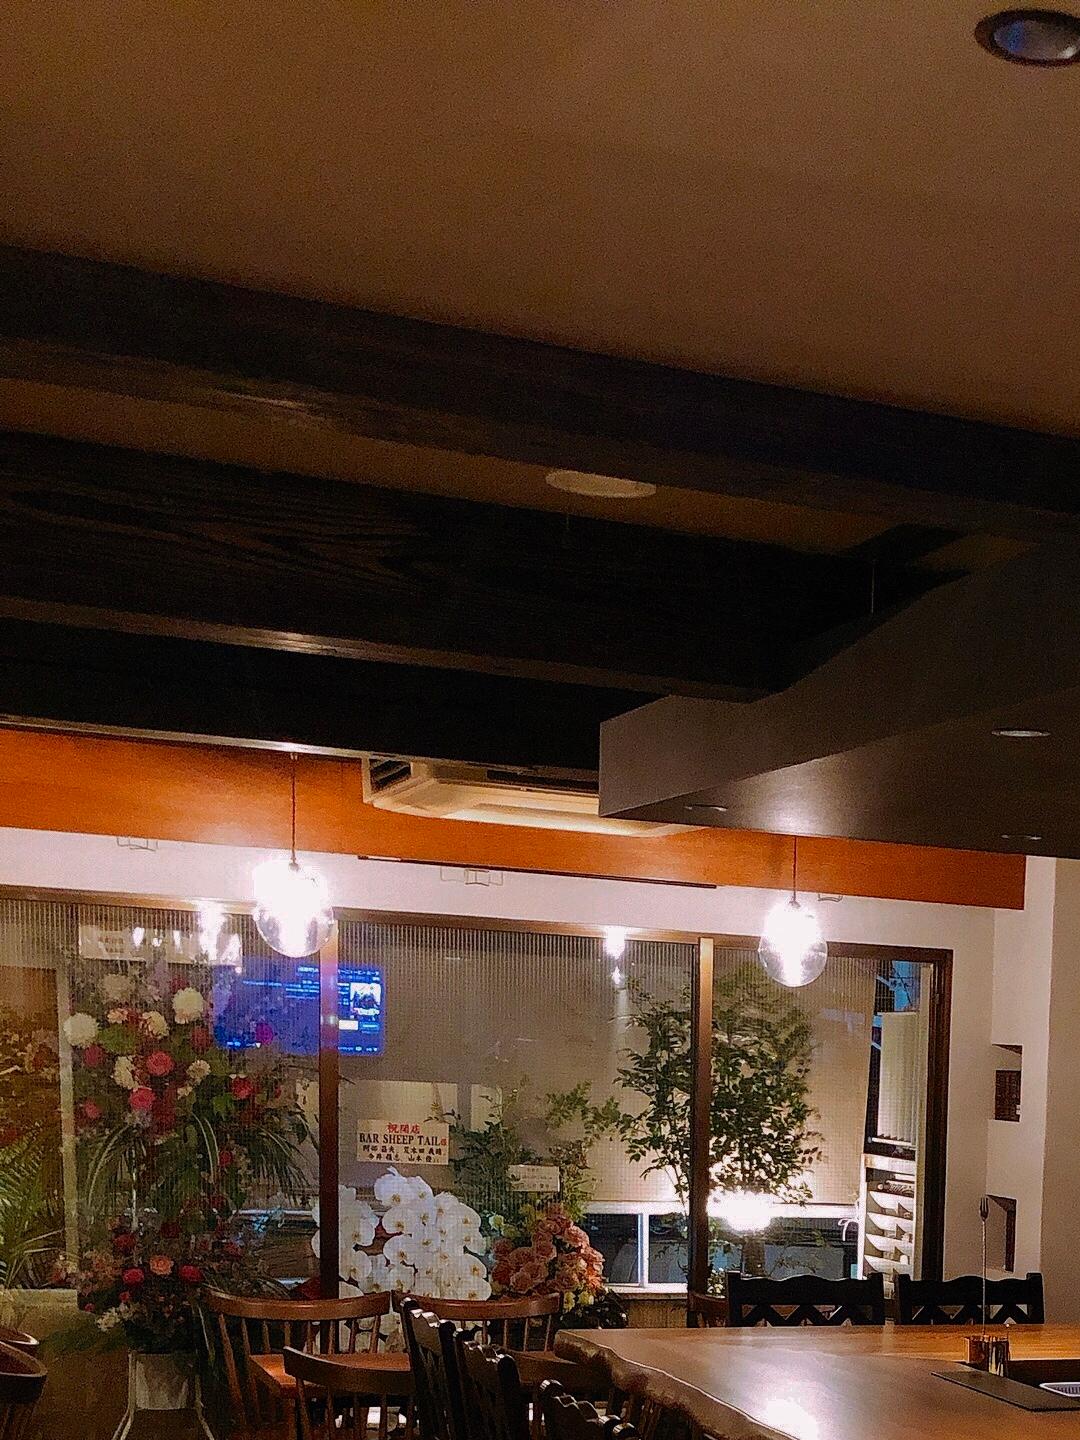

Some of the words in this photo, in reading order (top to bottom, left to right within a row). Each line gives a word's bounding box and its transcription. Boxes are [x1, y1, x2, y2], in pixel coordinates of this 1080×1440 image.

[360, 1133, 379, 1143] BAR
[383, 1134, 414, 1145] SHEEP
[418, 1135, 440, 1146] TAIL
